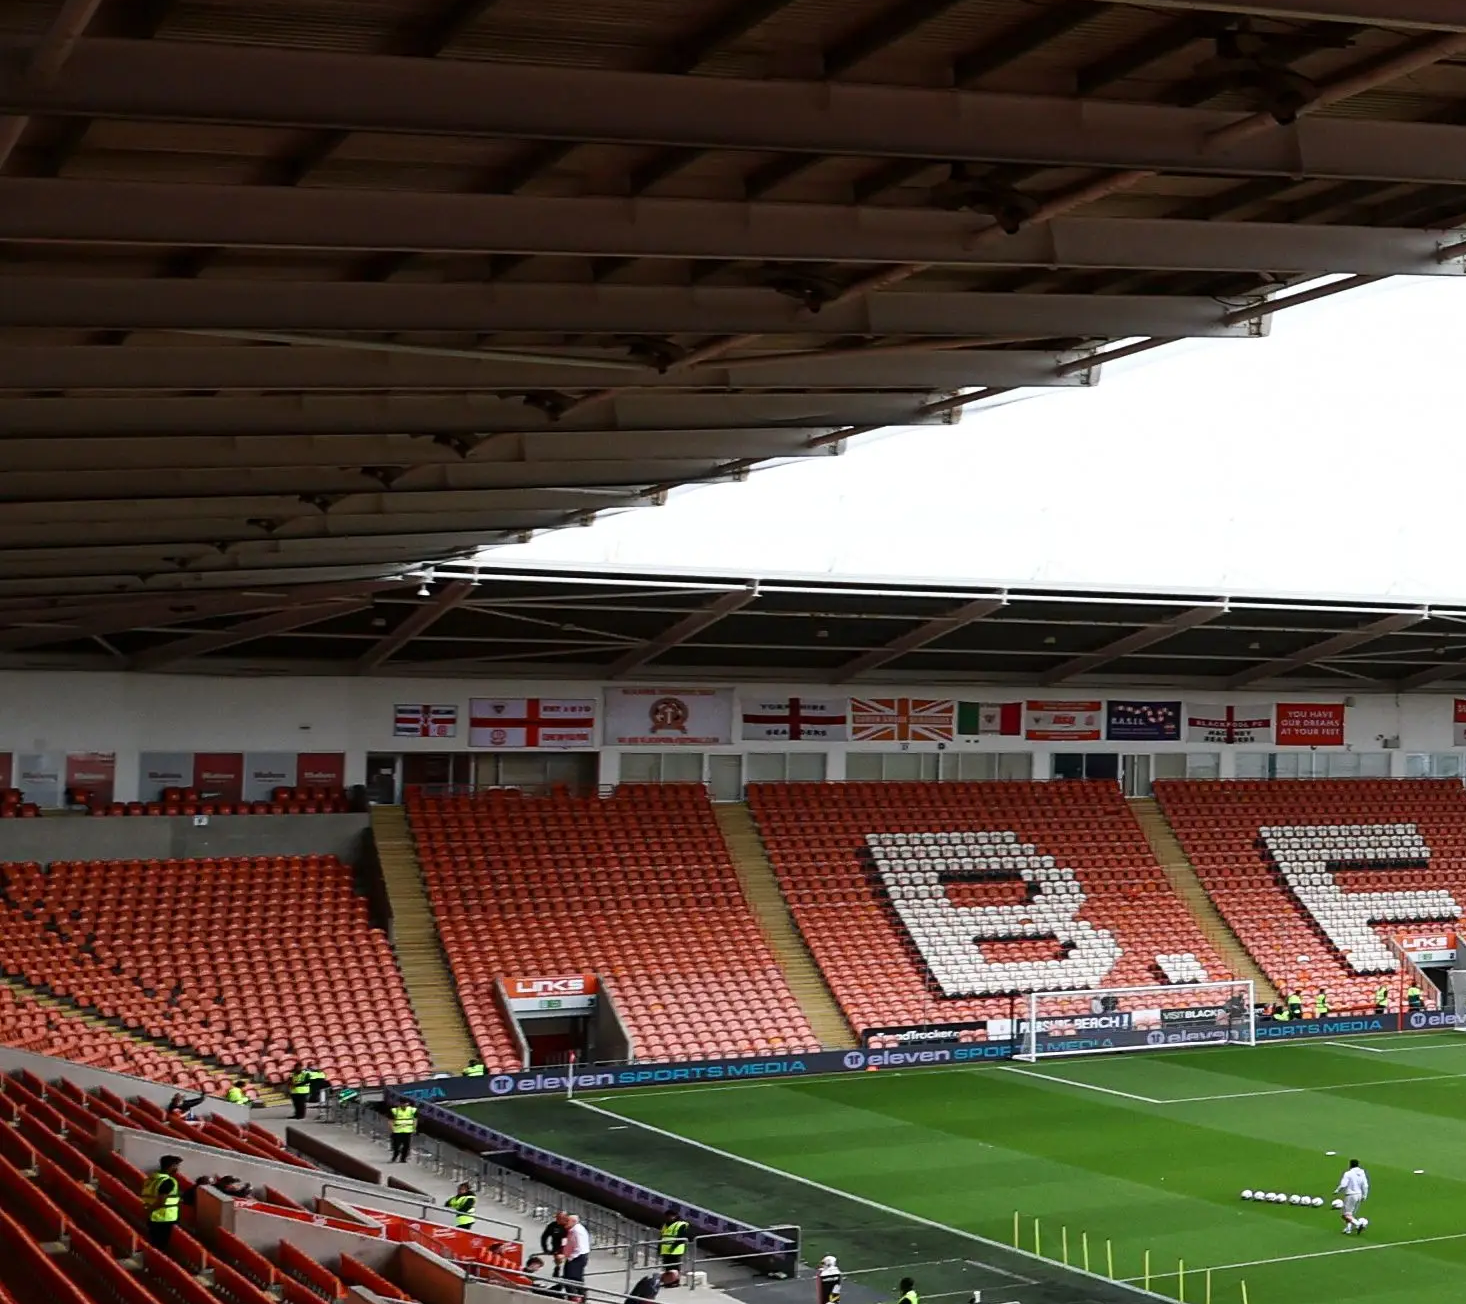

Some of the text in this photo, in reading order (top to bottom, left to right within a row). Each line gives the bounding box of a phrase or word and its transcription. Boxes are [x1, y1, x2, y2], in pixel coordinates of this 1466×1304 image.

[1322, 1018, 1383, 1034] MEDIA
[867, 1049, 949, 1066] eleven
[517, 1058, 806, 1093] eleven SPORTS MEDIA
